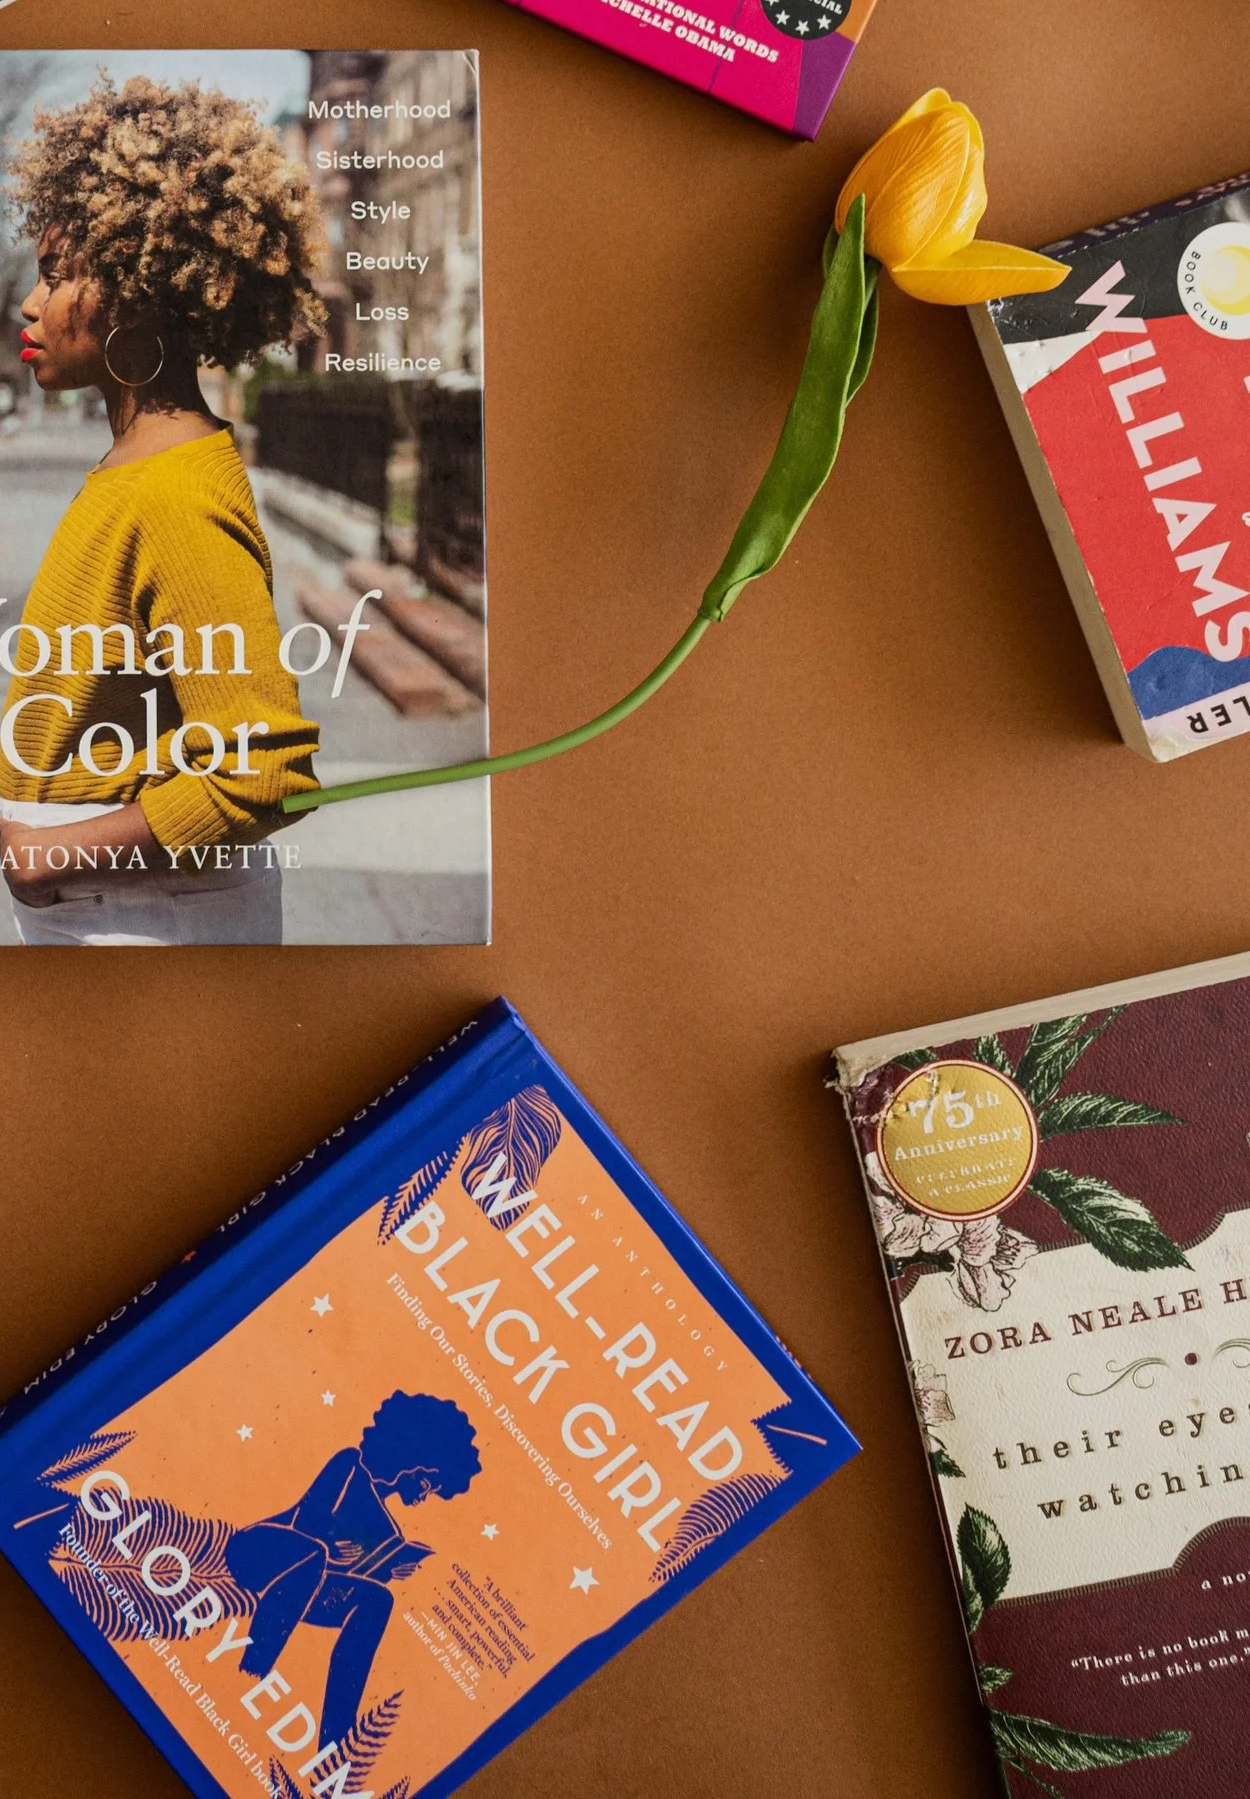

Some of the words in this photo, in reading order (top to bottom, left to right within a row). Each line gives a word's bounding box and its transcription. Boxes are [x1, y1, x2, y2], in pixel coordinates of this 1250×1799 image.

[673, 24, 737, 63] OBAMA
[718, 24, 780, 64] WORDS
[308, 99, 451, 119] Motherhood
[315, 149, 444, 170] Sisterhood
[349, 199, 412, 226] Style
[345, 250, 431, 276] Beauty
[1184, 250, 1202, 295] BOOK
[355, 301, 411, 322] Loss
[1192, 301, 1229, 331] CLUB
[324, 351, 442, 374] Resilience
[1075, 259, 1250, 663] WILLIAMS
[277, 587, 384, 700] of
[0, 688, 270, 777] Color
[165, 843, 303, 872] YVETTE
[908, 1089, 1002, 1135] 75th
[893, 1124, 1024, 1162] Anniversary
[576, 1193, 605, 1222] AN
[611, 1236, 728, 1371] ANTHOLOGY
[470, 1150, 744, 1482] WELL-READ
[942, 1320, 1054, 1362] ZORA
[1067, 1287, 1203, 1337] NEALE
[393, 1199, 570, 1405] BLACK
[560, 1402, 680, 1553] GIRL
[384, 1270, 435, 1332] Finding
[428, 1323, 457, 1357] Our
[450, 1352, 493, 1409] Stories,
[492, 1402, 562, 1488] Discovering
[556, 1480, 614, 1551] Ourselves
[992, 1429, 1122, 1470] their
[1158, 1402, 1250, 1439] eye
[79, 1469, 254, 1663] GLORY
[1138, 1645, 1156, 1661] is
[1162, 1641, 1183, 1655] no
[1187, 1629, 1230, 1650] book
